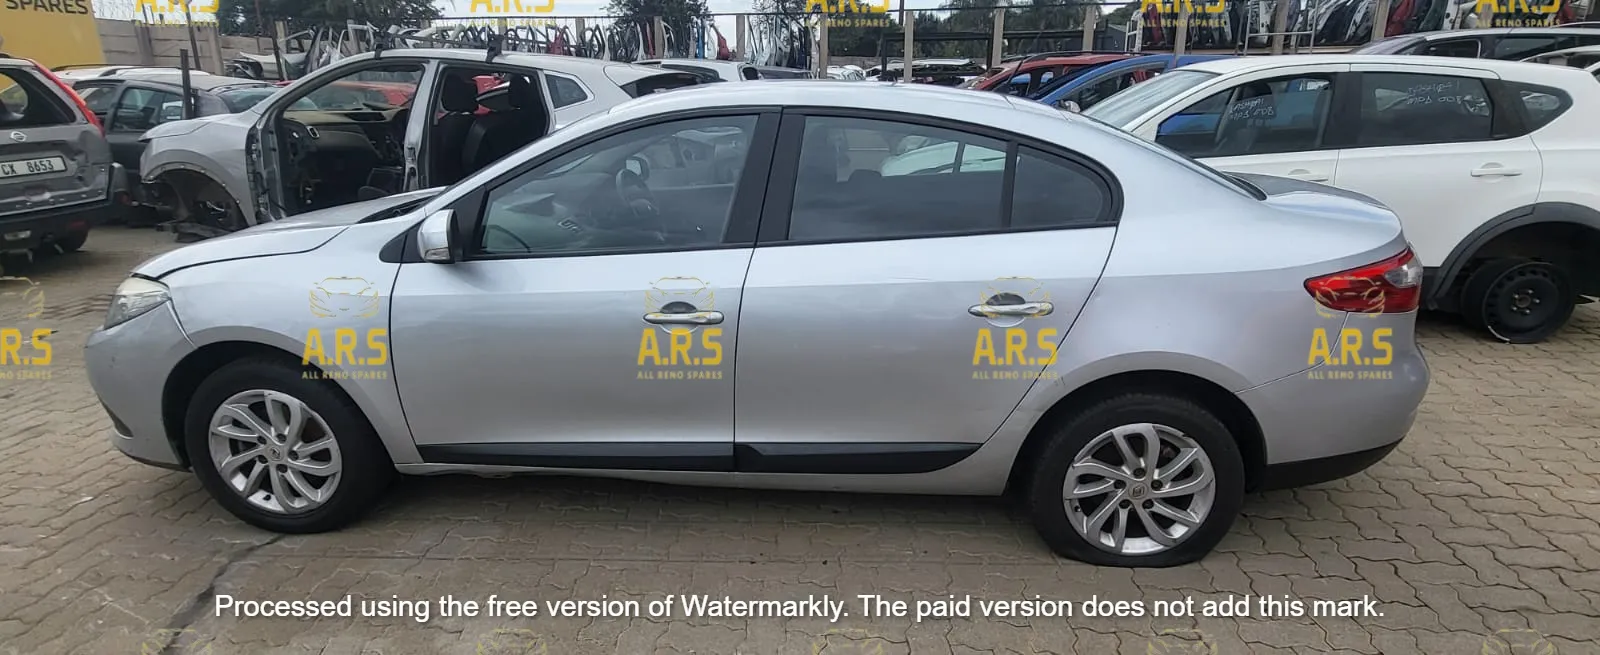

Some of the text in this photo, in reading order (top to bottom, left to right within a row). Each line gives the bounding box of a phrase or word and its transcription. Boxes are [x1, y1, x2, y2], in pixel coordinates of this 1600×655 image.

[6, 0, 88, 14] SPARES
[1, 159, 54, 176] CX 8653
